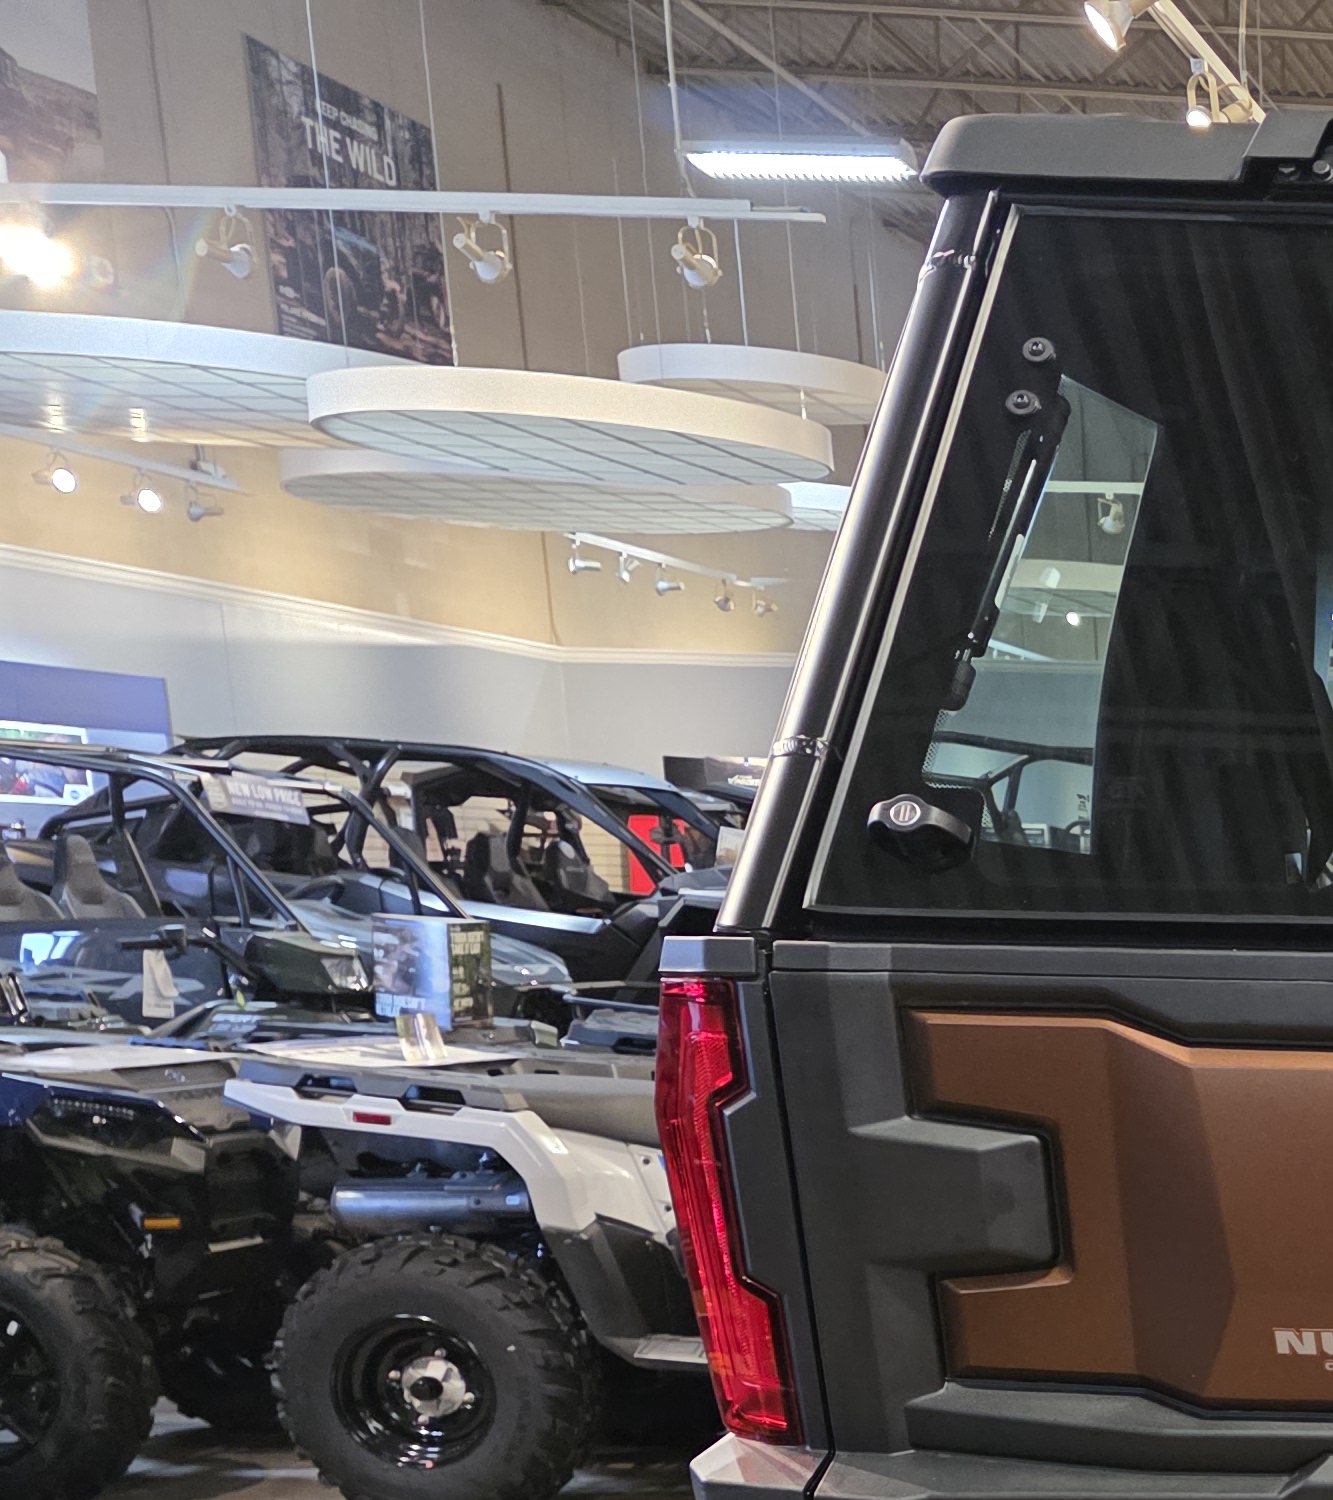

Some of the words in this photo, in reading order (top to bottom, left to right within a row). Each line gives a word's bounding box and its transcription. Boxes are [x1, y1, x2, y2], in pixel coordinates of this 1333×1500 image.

[317, 100, 339, 120] EEP
[301, 115, 343, 164] THE
[345, 135, 397, 187] WILD
